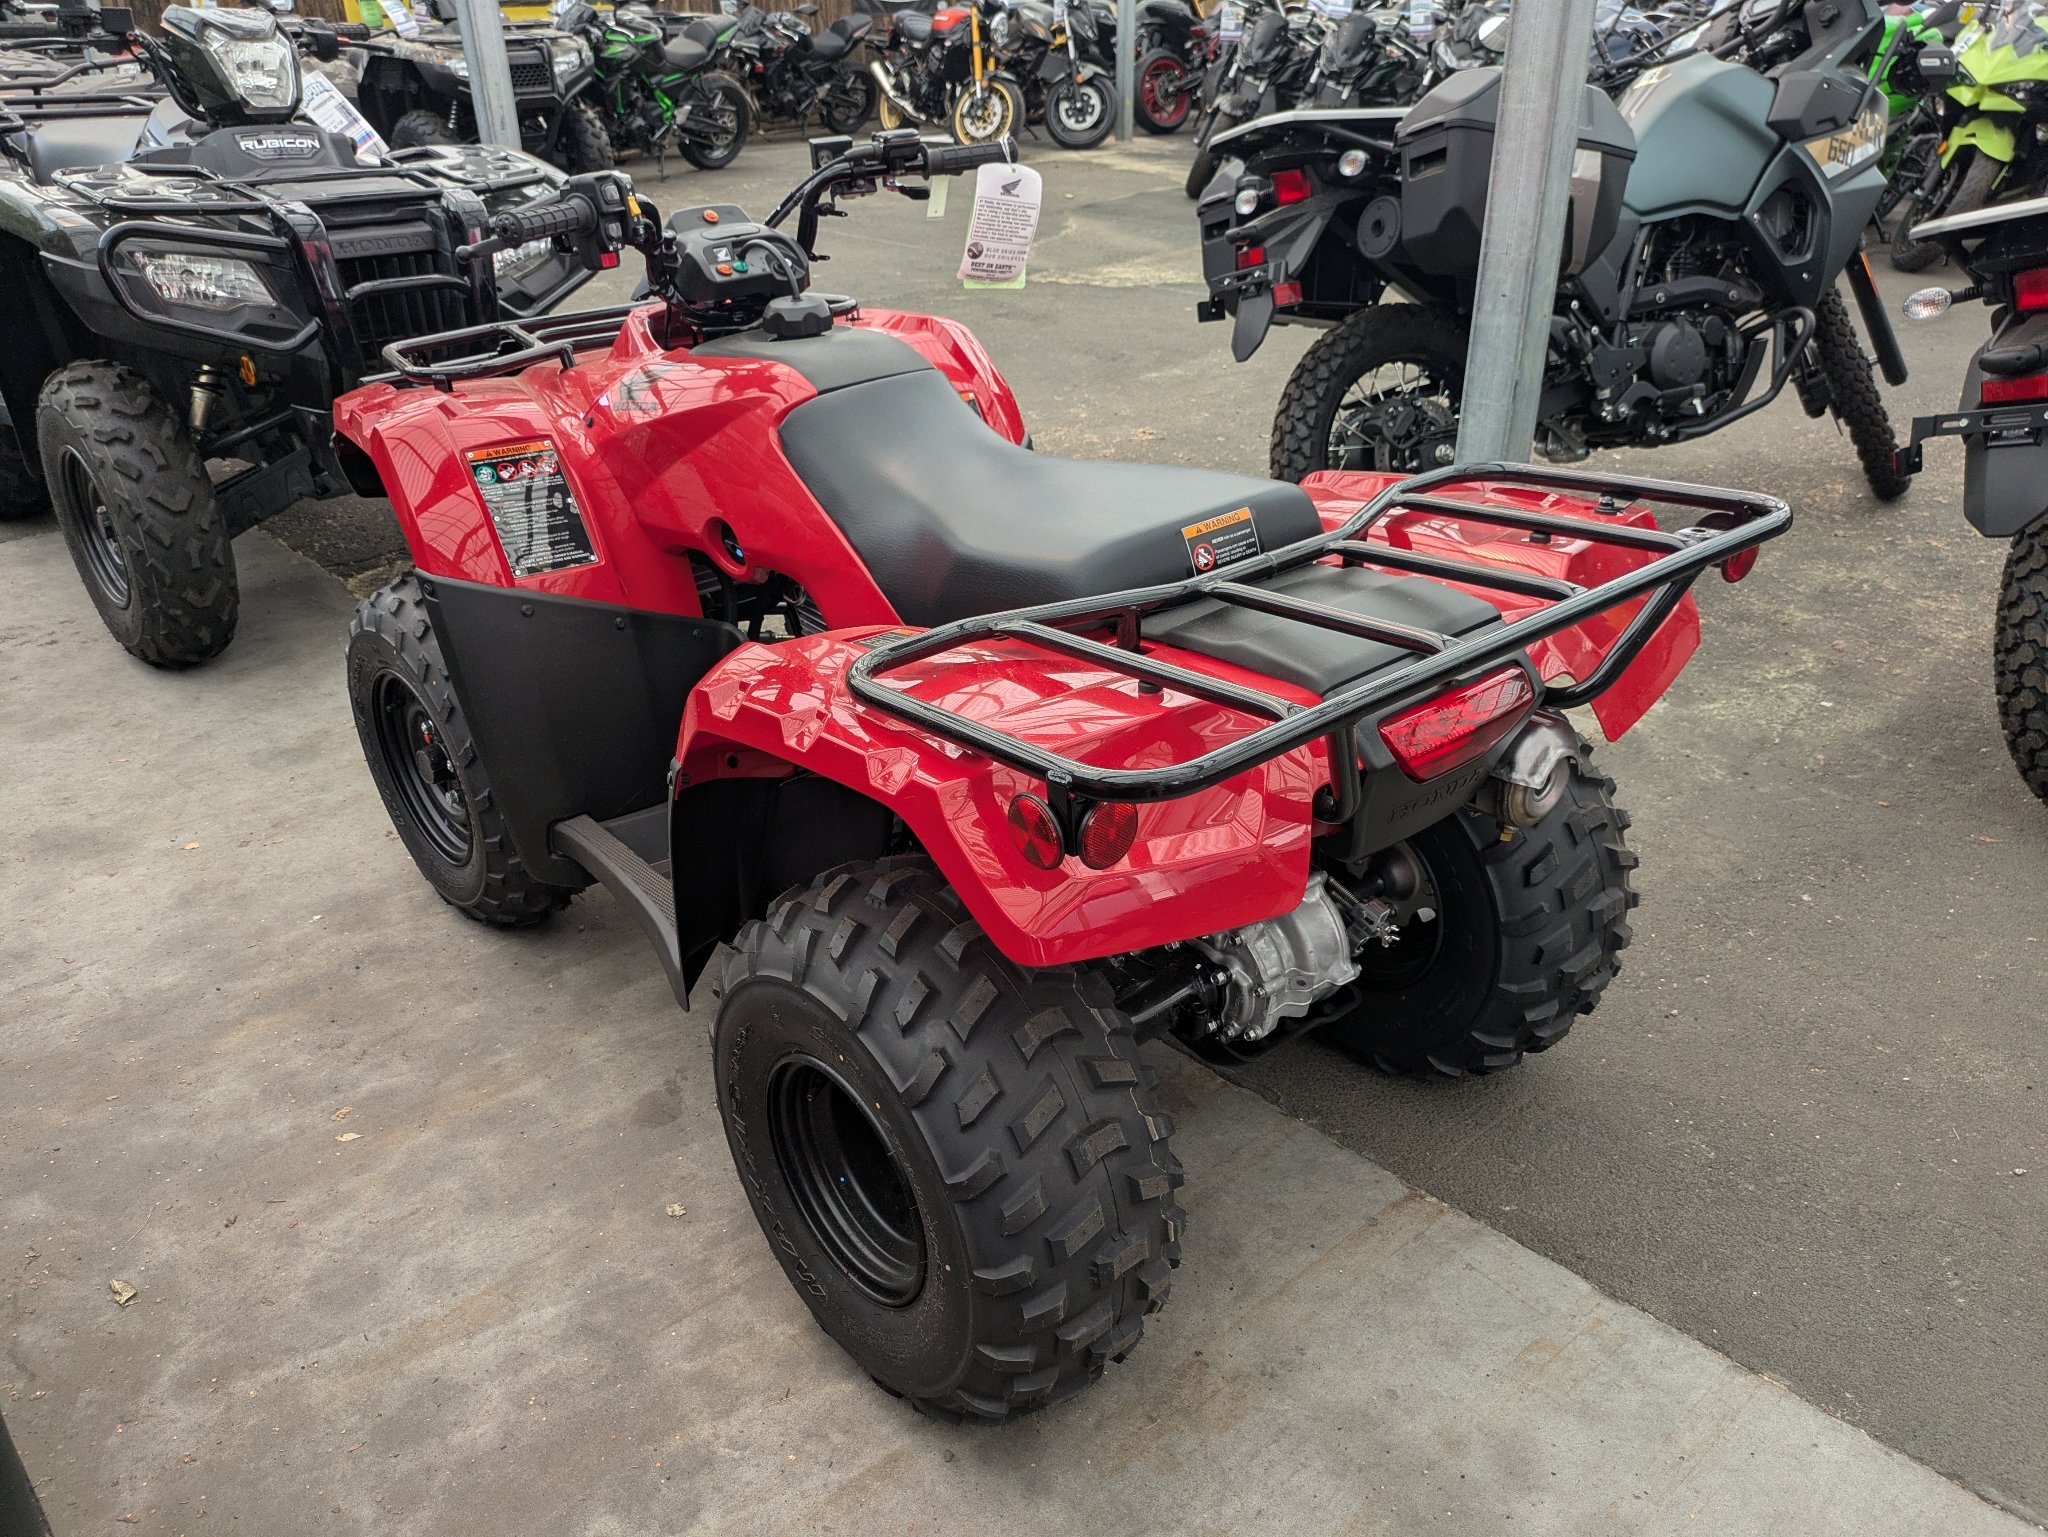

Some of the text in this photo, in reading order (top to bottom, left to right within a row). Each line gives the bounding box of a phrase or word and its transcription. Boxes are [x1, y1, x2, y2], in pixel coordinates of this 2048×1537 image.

[240, 139, 320, 150] RUBICON
[1828, 137, 1855, 167] 650
[336, 235, 430, 253] HONDA
[613, 402, 656, 412] HONDA
[493, 445, 530, 456] WARNING
[1204, 513, 1240, 530] WARNING
[1388, 766, 1484, 824] HONDA
